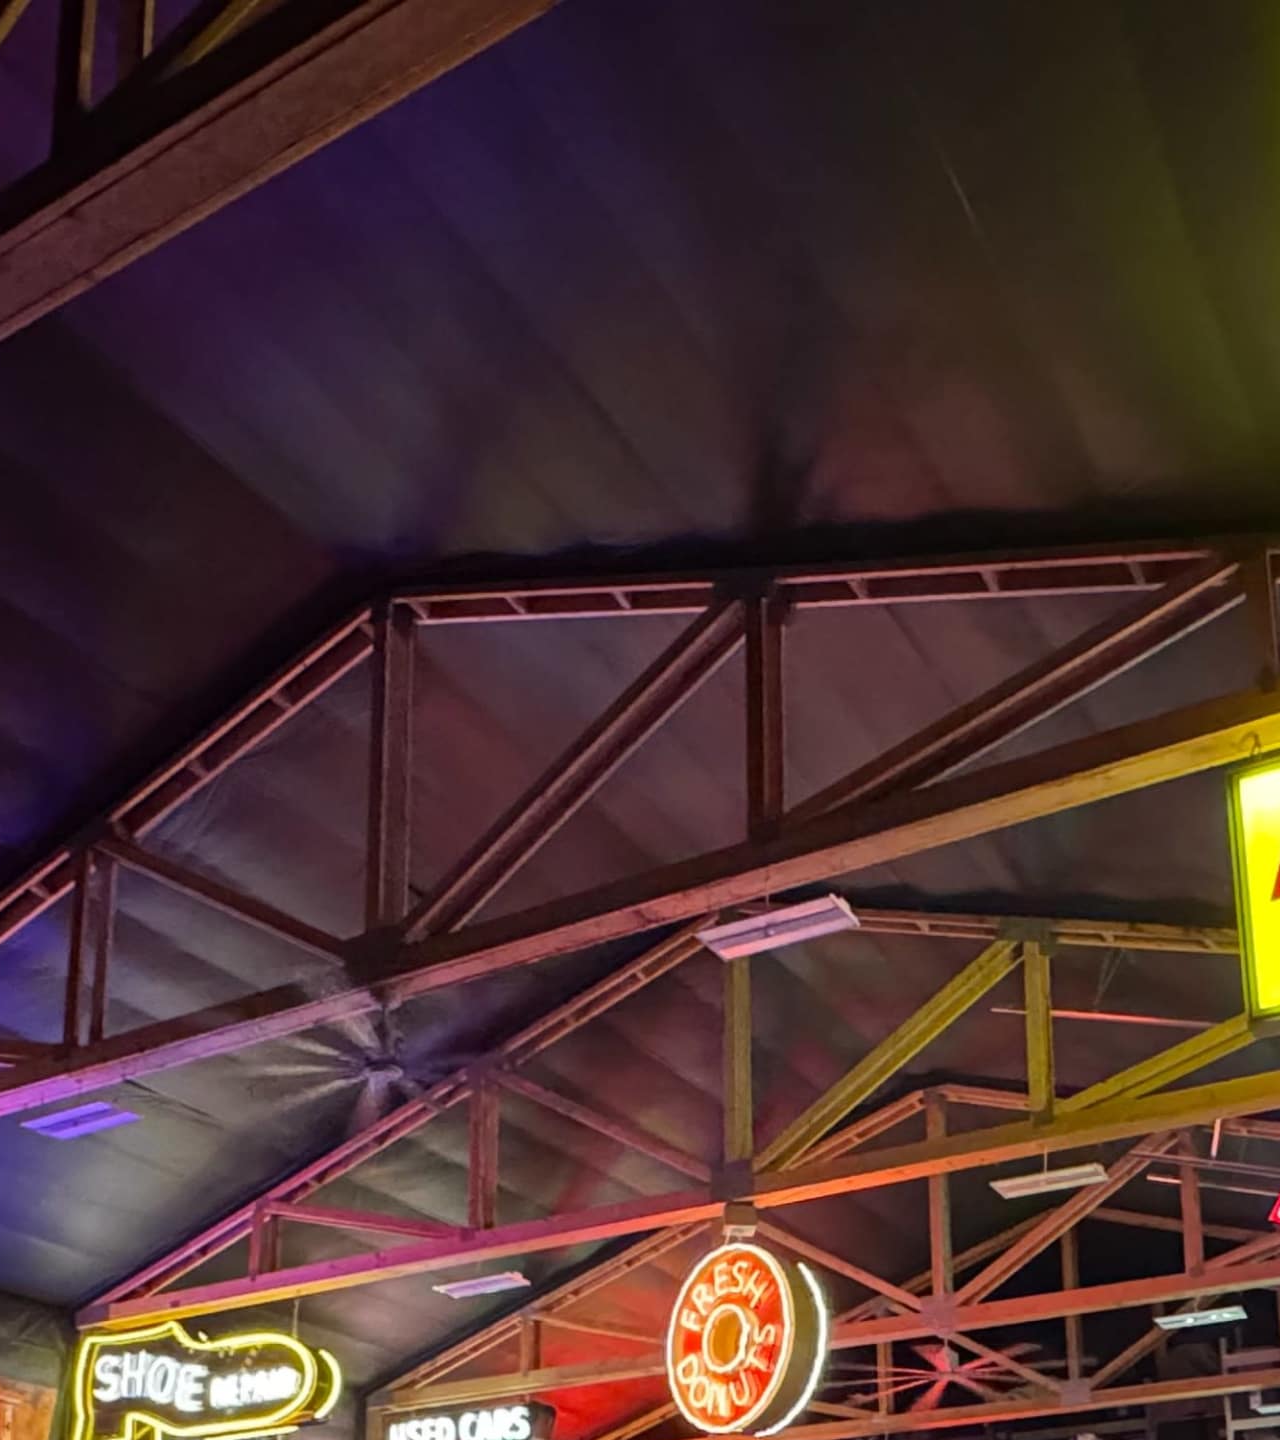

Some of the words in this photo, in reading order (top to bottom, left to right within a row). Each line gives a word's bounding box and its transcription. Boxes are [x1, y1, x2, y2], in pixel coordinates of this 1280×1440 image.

[680, 1261, 768, 1332] FRESH
[92, 1349, 210, 1413] SHOE
[676, 1323, 778, 1418] DONUTS
